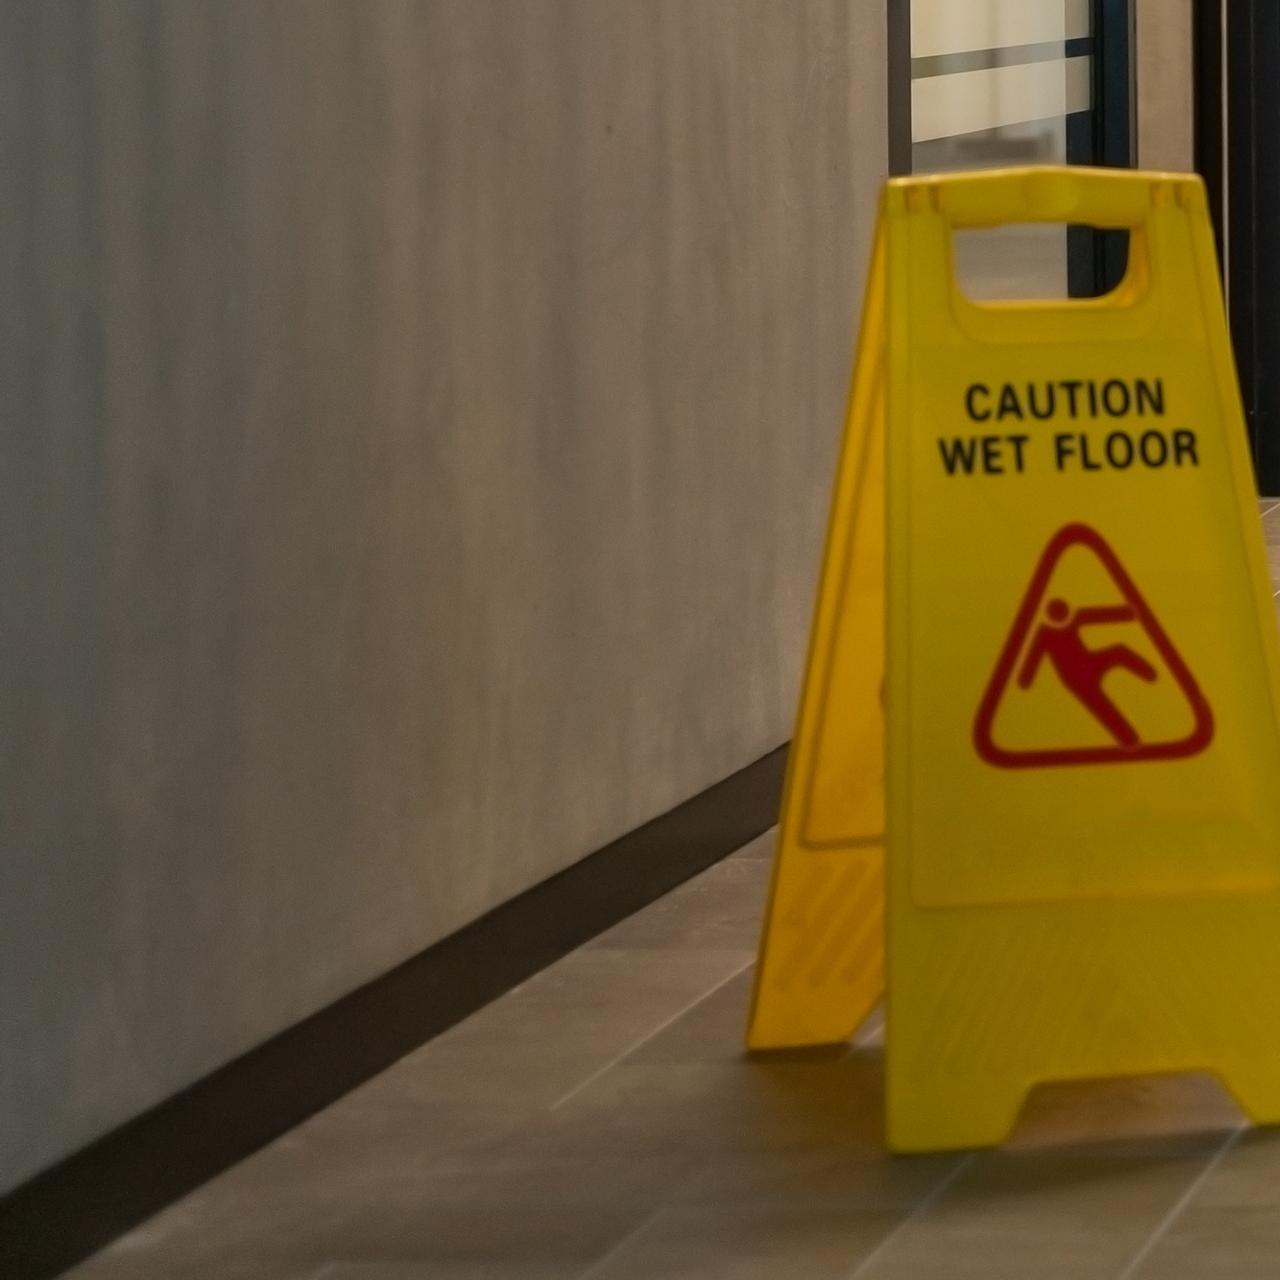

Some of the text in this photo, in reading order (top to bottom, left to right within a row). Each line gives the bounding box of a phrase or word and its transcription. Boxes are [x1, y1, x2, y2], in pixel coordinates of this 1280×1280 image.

[965, 377, 1166, 422] CAUTION
[938, 428, 1200, 477] WET FLOOR
